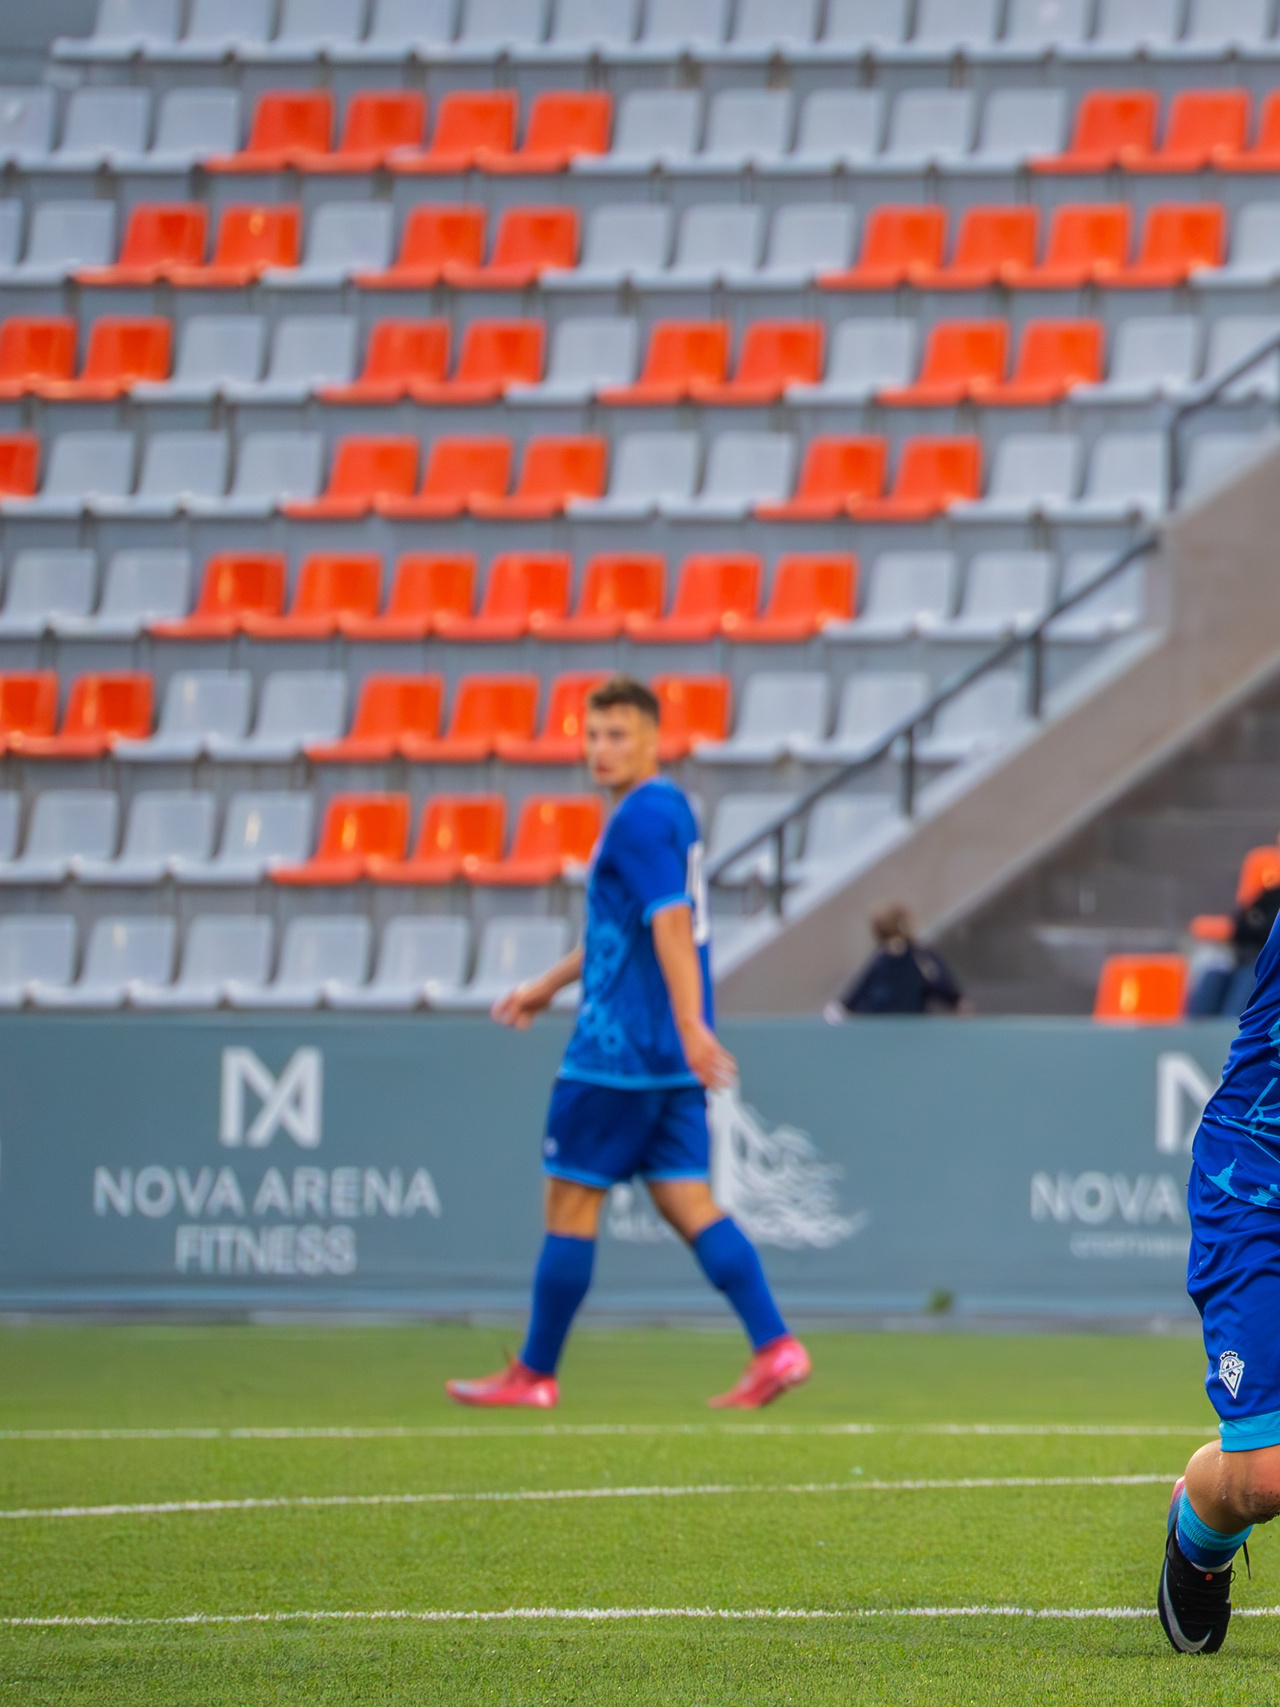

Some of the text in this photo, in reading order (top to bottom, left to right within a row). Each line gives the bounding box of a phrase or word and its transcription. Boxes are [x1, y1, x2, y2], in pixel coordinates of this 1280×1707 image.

[94, 1166, 441, 1219] NOVA ARENA
[1031, 1171, 1183, 1223] NOVA
[175, 1224, 356, 1275] FITNESS
